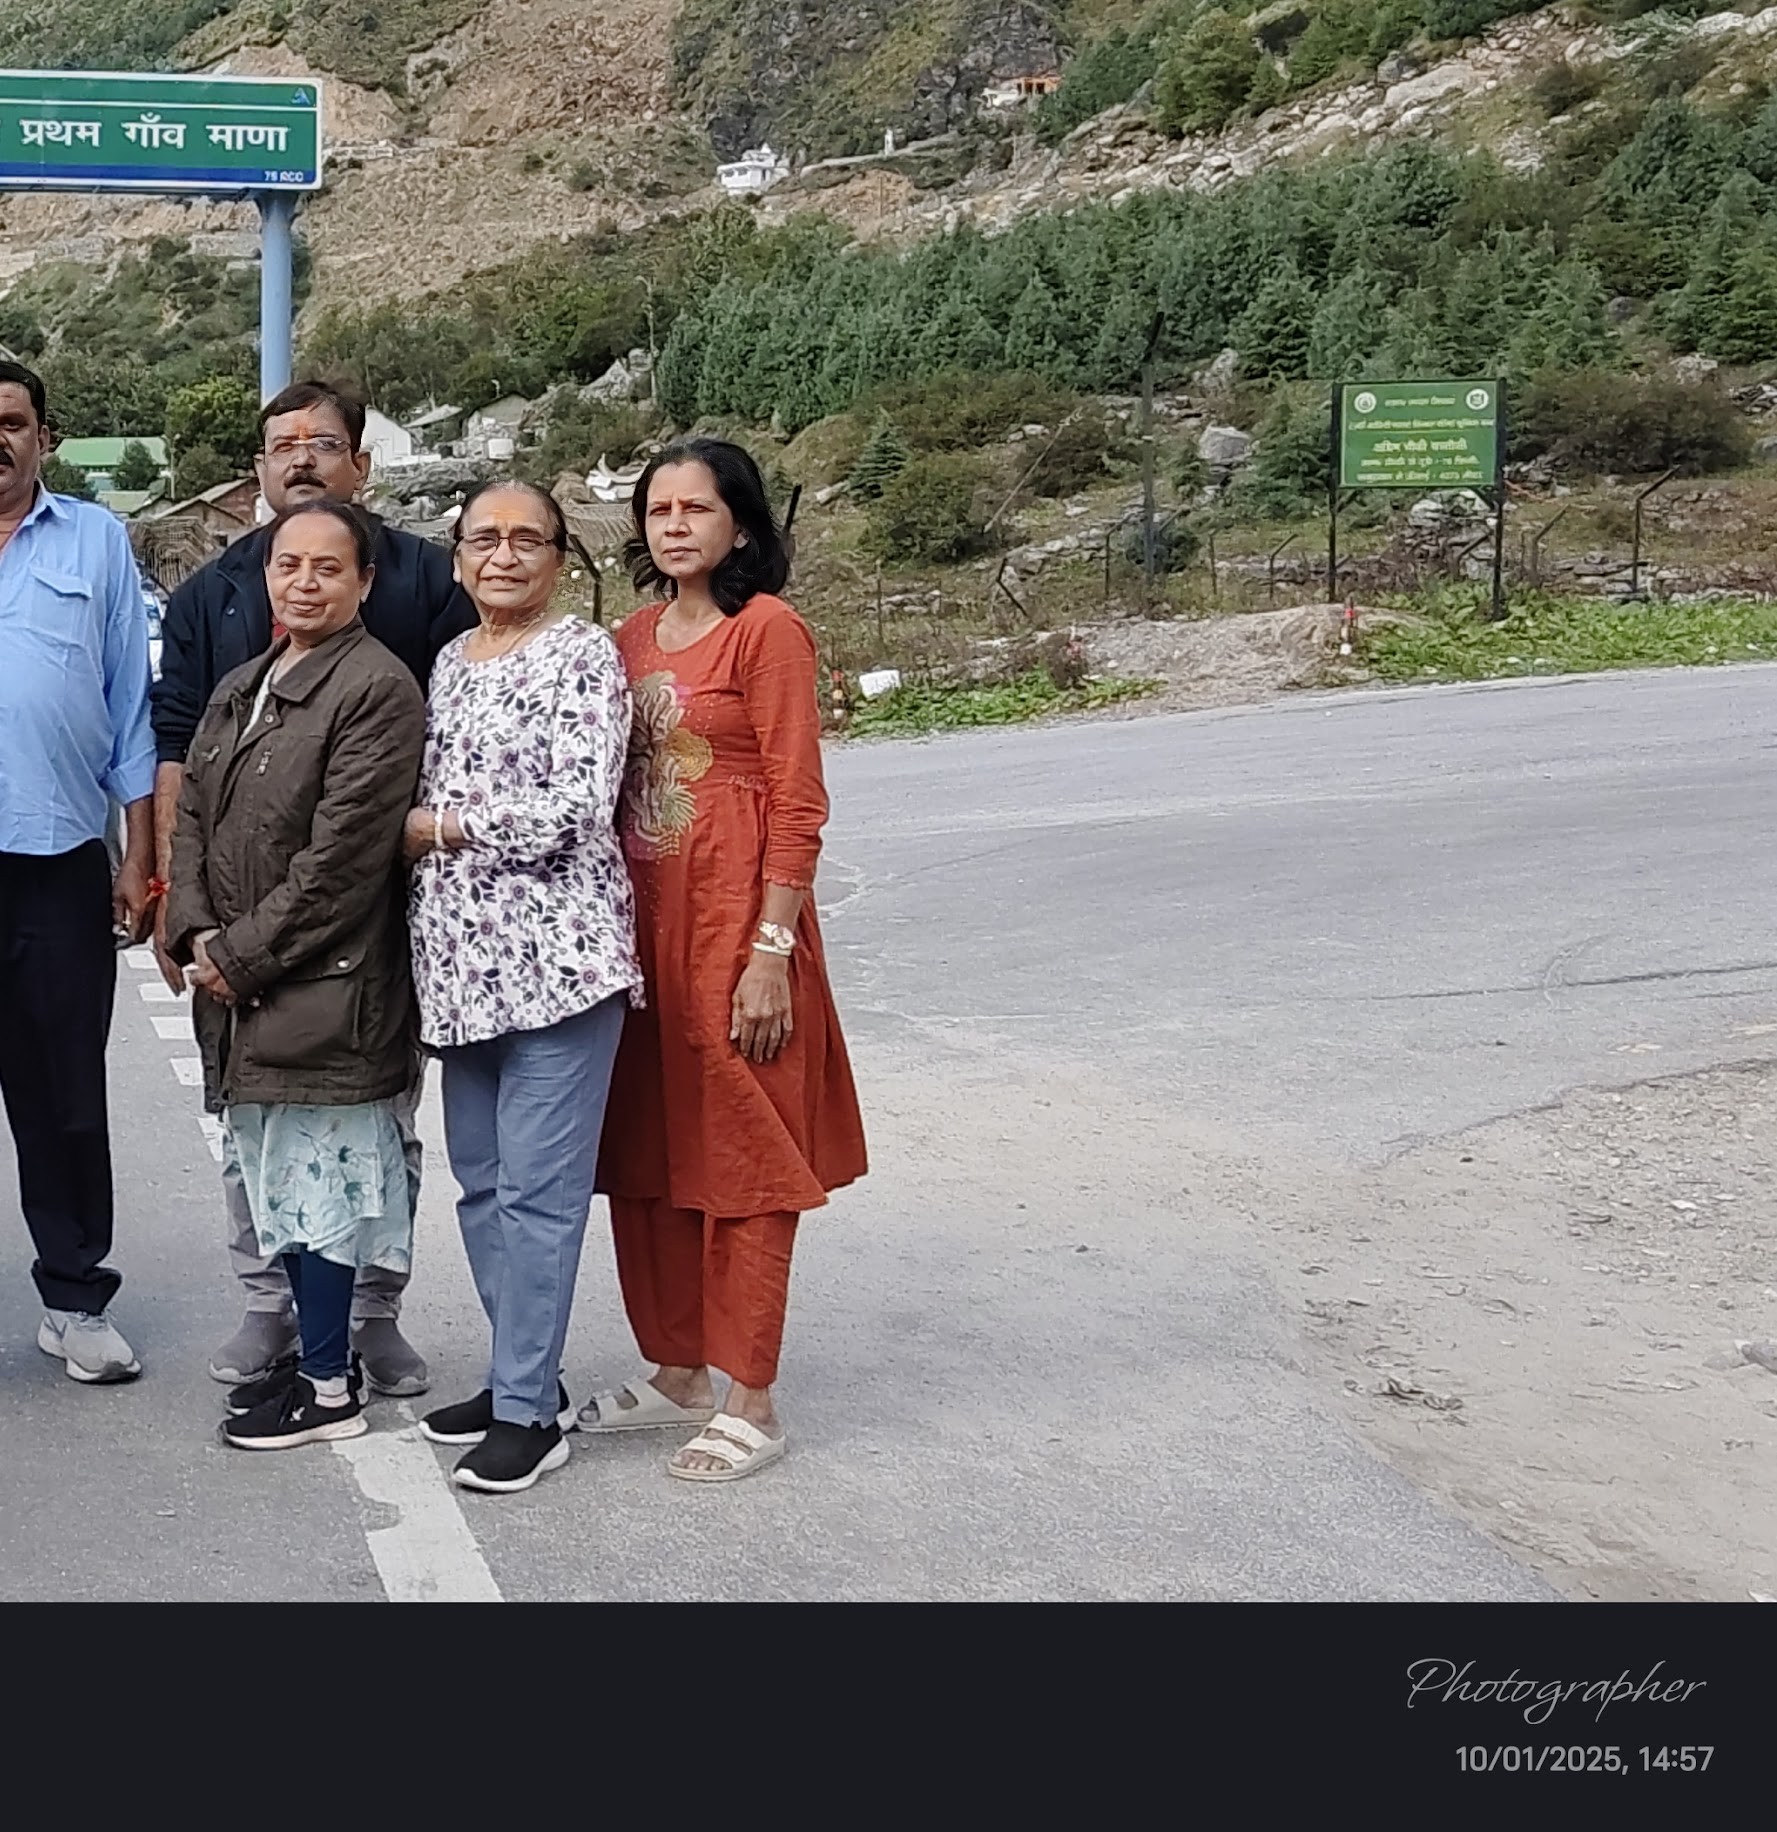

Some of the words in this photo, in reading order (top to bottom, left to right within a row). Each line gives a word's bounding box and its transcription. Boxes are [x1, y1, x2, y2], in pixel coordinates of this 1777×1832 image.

[19, 119, 102, 147] प्रथम
[121, 112, 187, 149] गाँव
[206, 124, 288, 151] माणा
